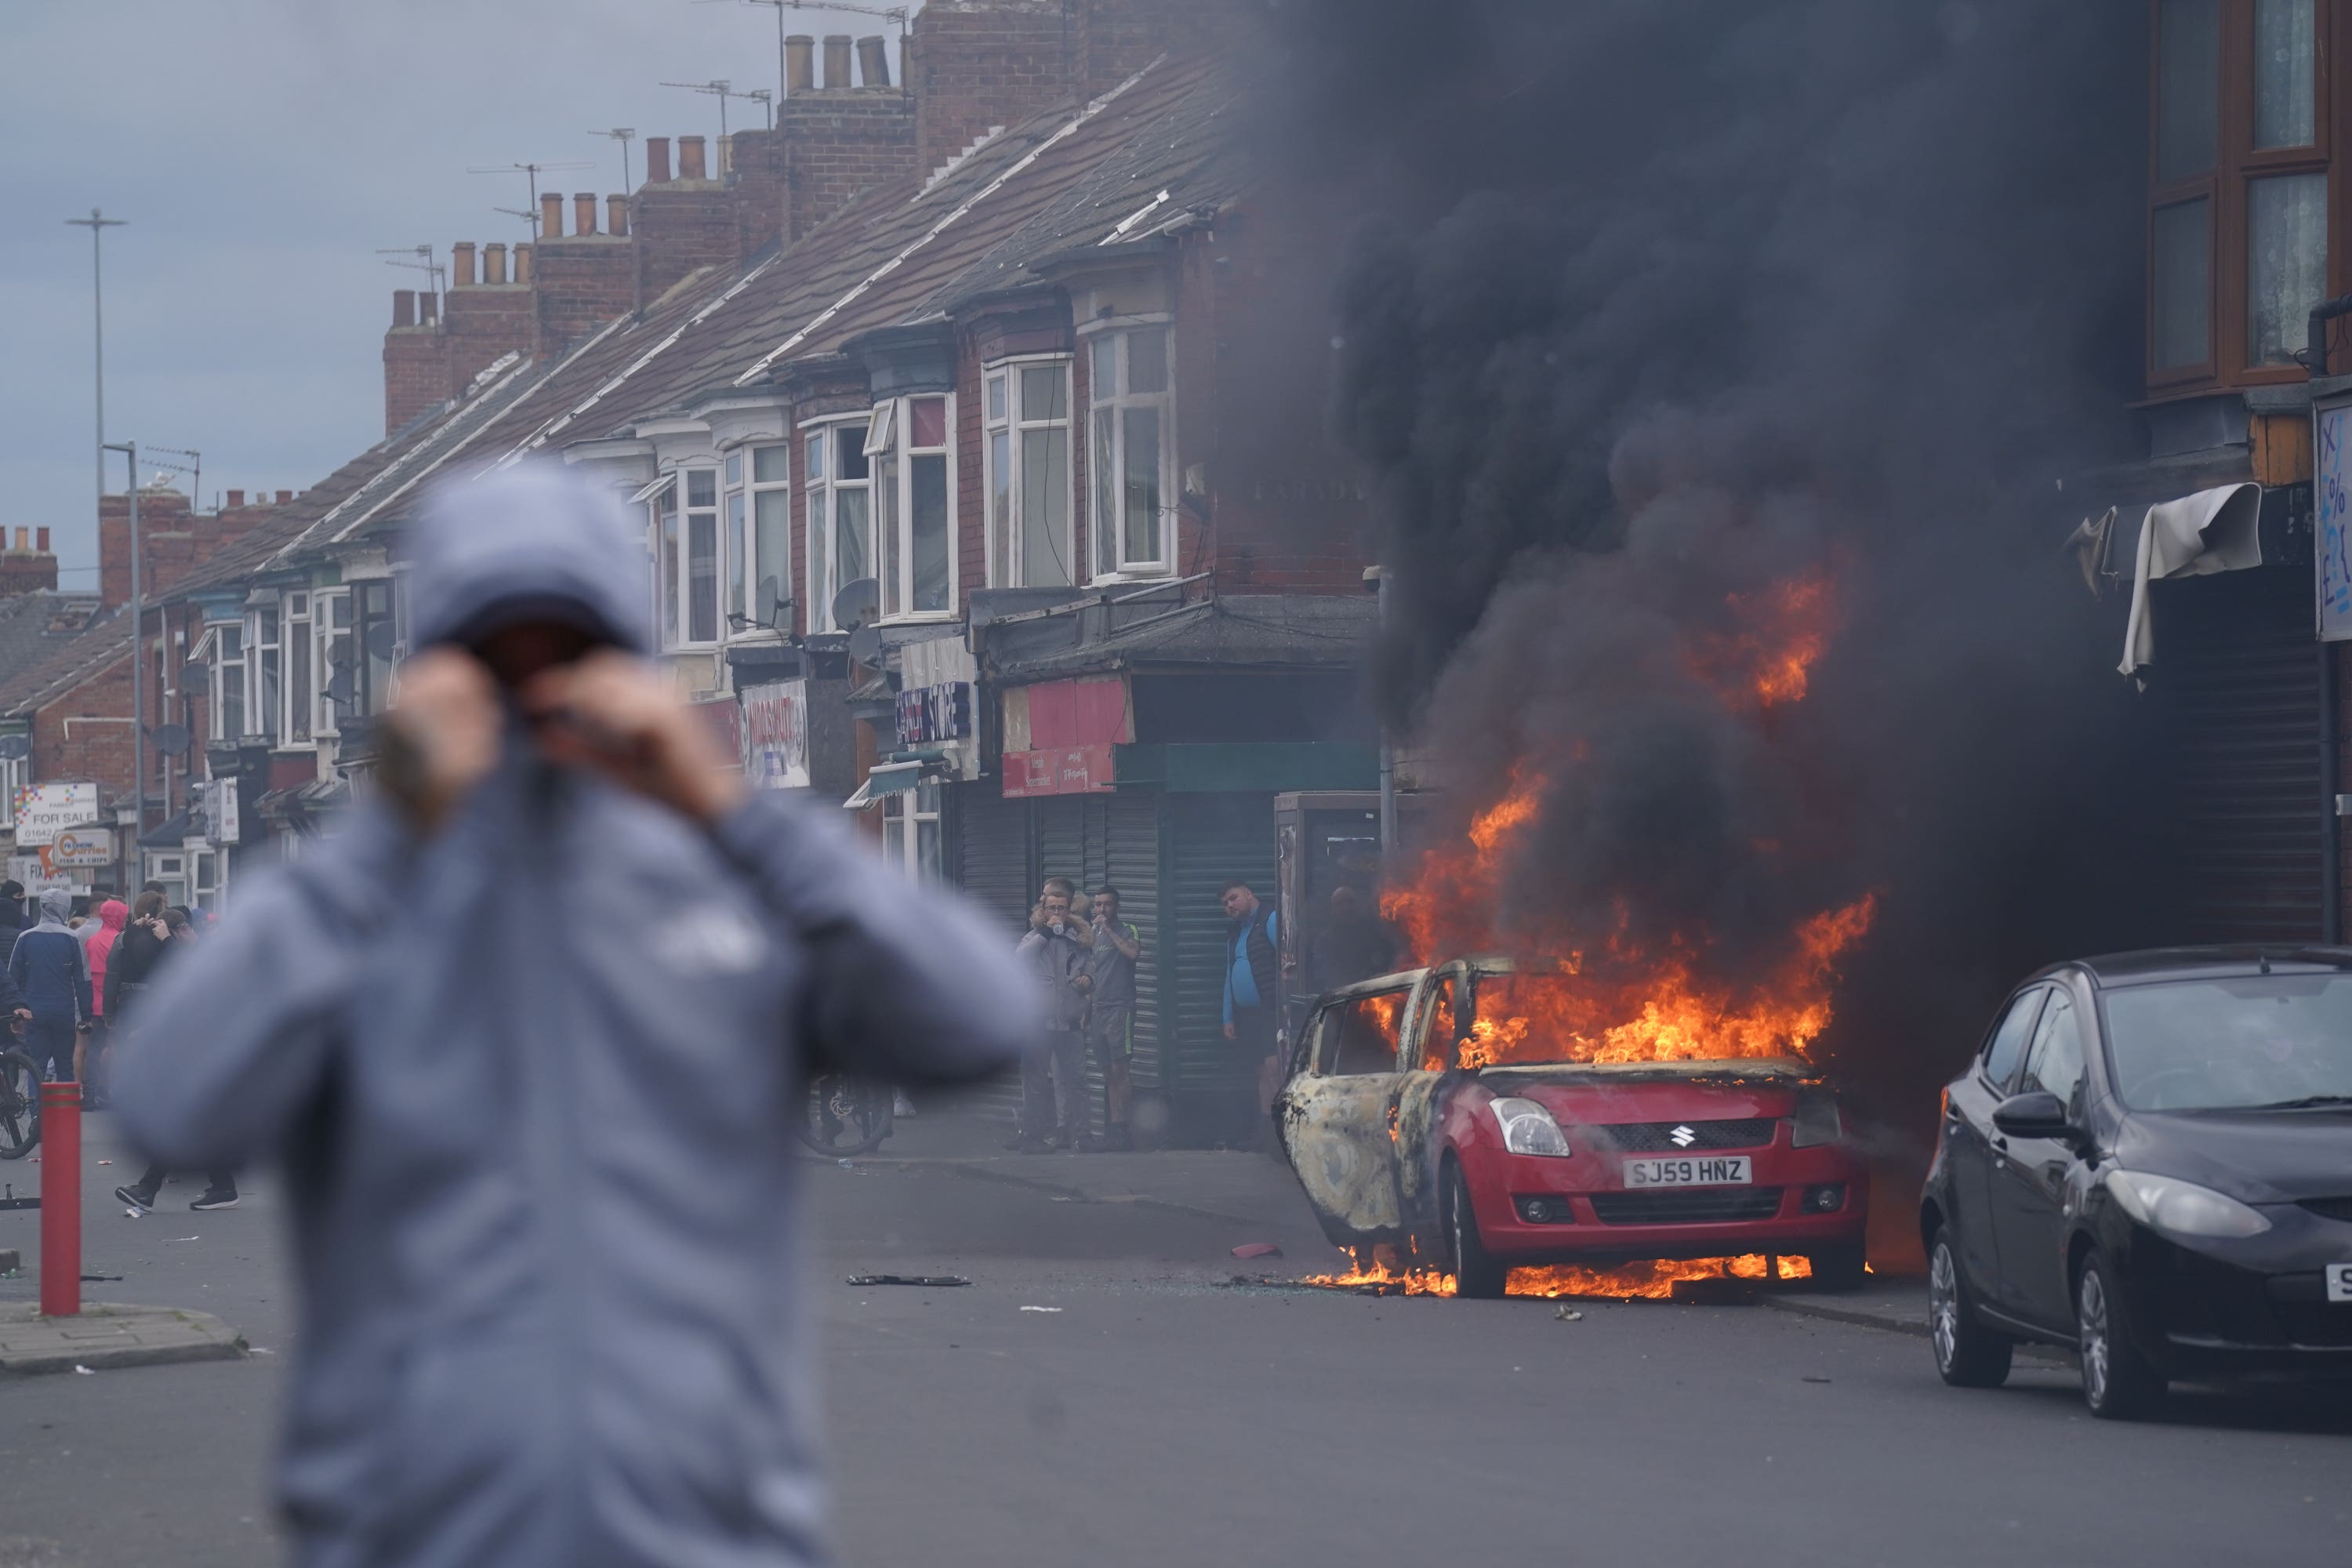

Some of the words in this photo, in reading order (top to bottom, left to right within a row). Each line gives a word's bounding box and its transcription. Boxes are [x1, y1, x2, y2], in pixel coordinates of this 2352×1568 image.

[928, 681, 958, 742] STORE
[33, 814, 59, 825] FOR
[64, 812, 94, 823] SALE
[1633, 1162, 1693, 1183] SJ59
[1698, 1160, 1742, 1181] HNZ
